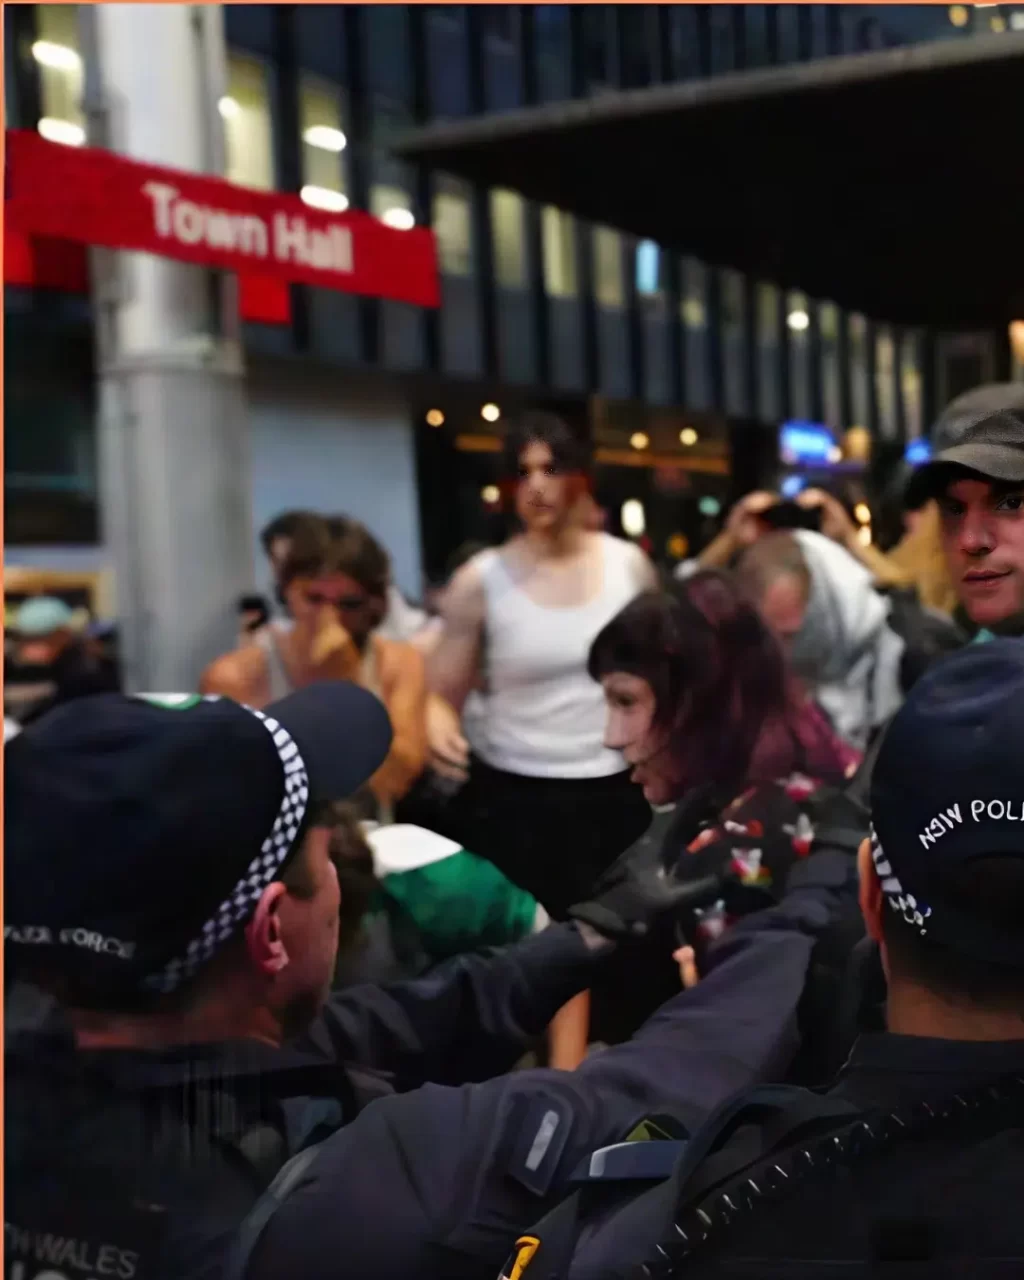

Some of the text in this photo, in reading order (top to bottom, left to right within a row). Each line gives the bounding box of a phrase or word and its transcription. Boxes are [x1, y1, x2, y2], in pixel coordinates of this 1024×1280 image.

[143, 181, 355, 273] Town Hall
[34, 1232, 140, 1280] WALES
